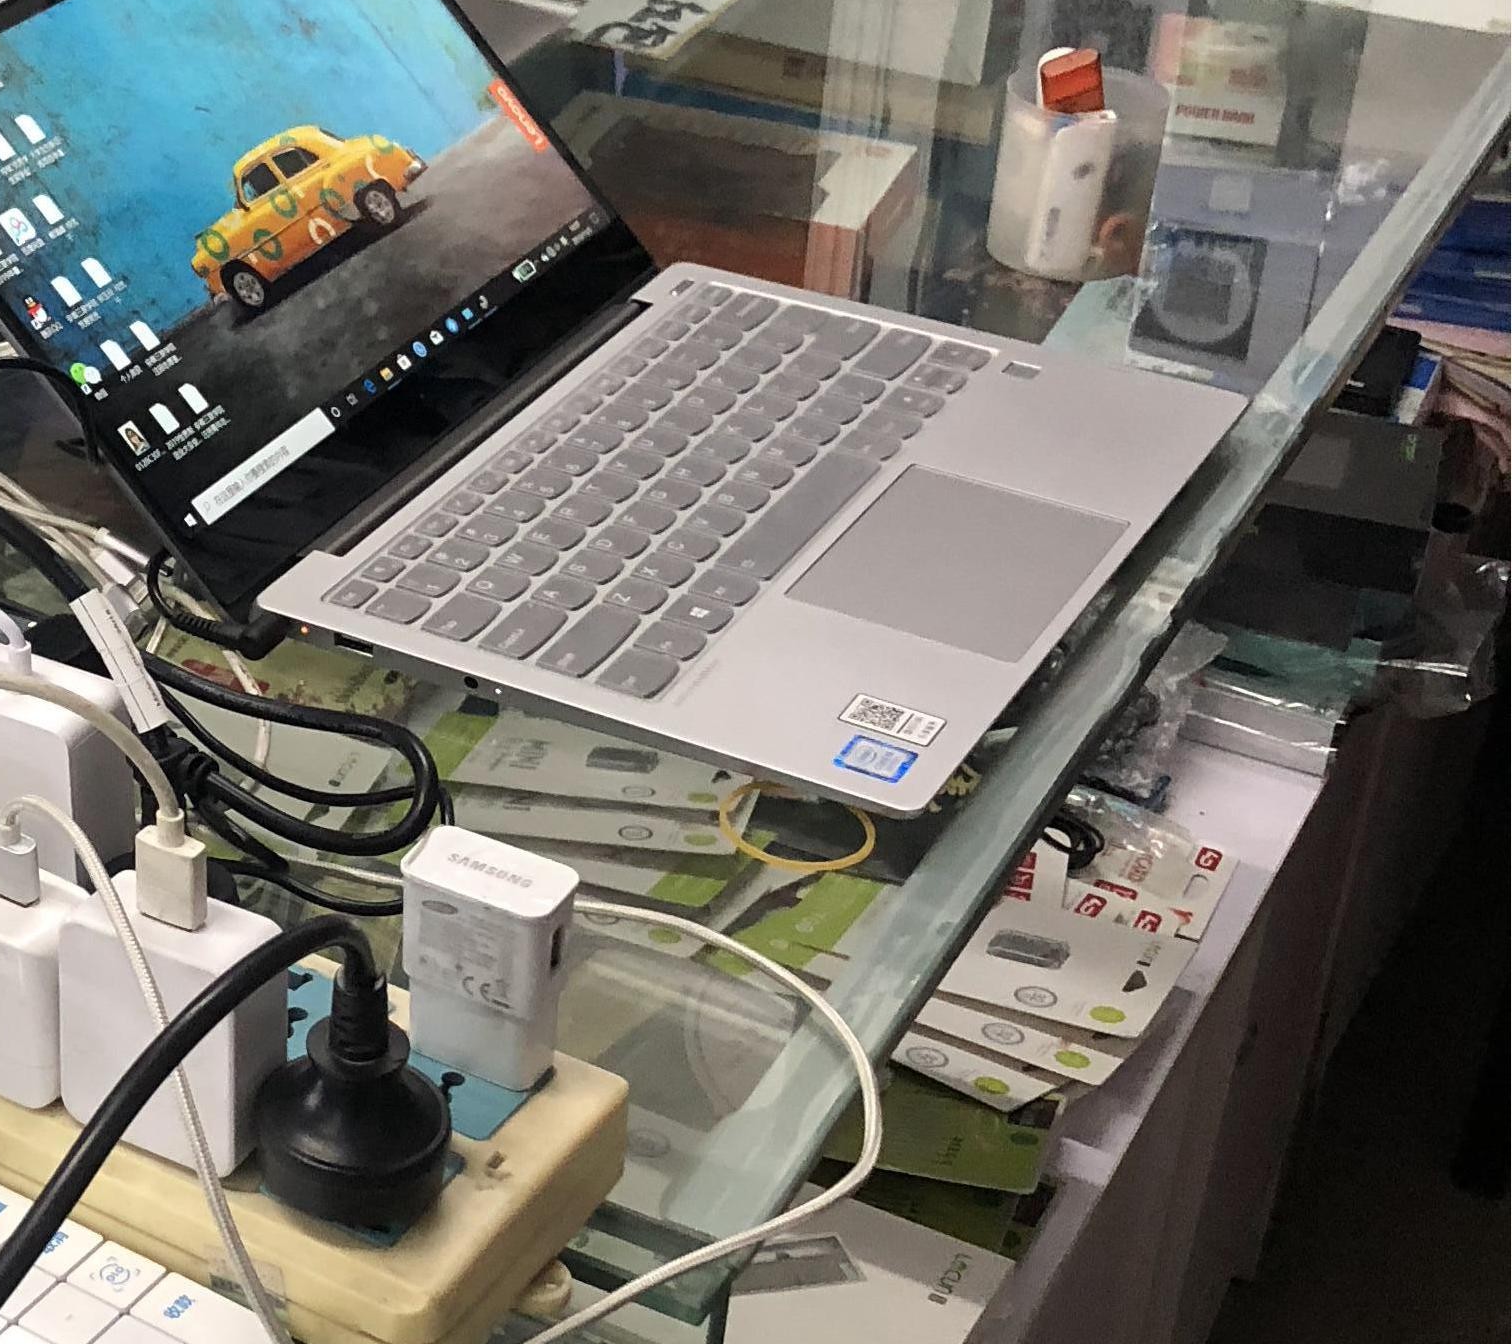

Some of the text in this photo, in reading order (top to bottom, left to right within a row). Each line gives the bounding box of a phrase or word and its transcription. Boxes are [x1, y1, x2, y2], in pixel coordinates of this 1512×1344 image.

[497, 85, 545, 149] Lenovo
[446, 853, 534, 889] SAMSUNG
[160, 1293, 197, 1321] 收款
